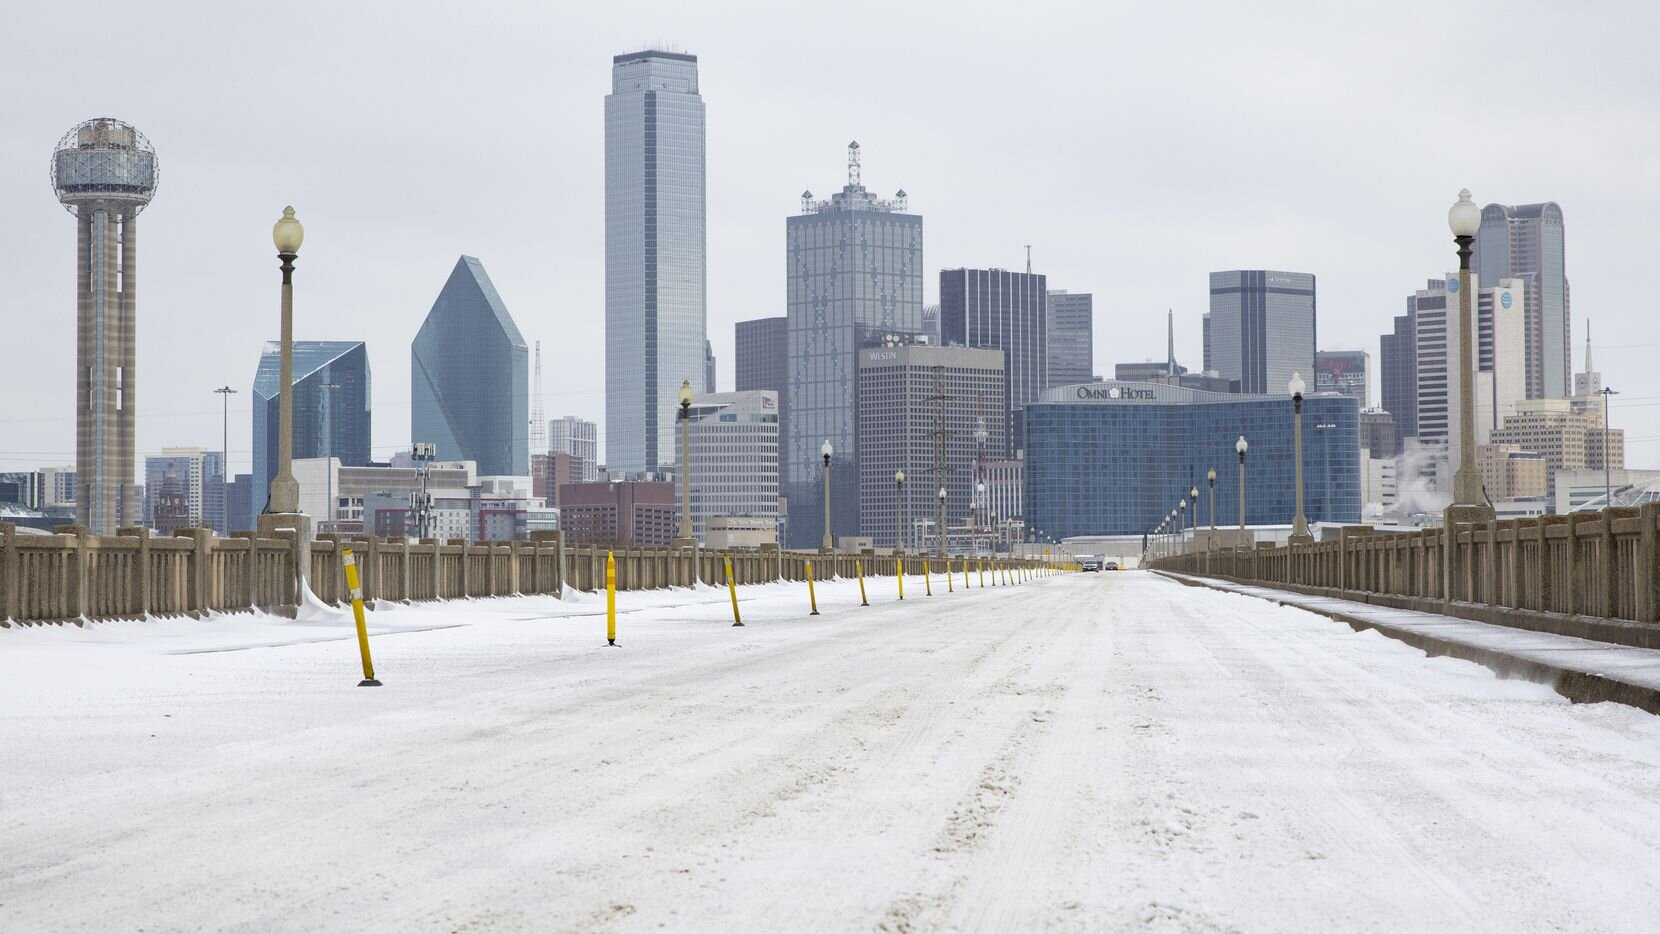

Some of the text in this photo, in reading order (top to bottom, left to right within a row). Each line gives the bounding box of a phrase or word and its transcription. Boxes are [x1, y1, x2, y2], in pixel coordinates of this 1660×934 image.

[869, 351, 897, 361] WESTIN
[1077, 386, 1157, 400] OMNI HOTEL
